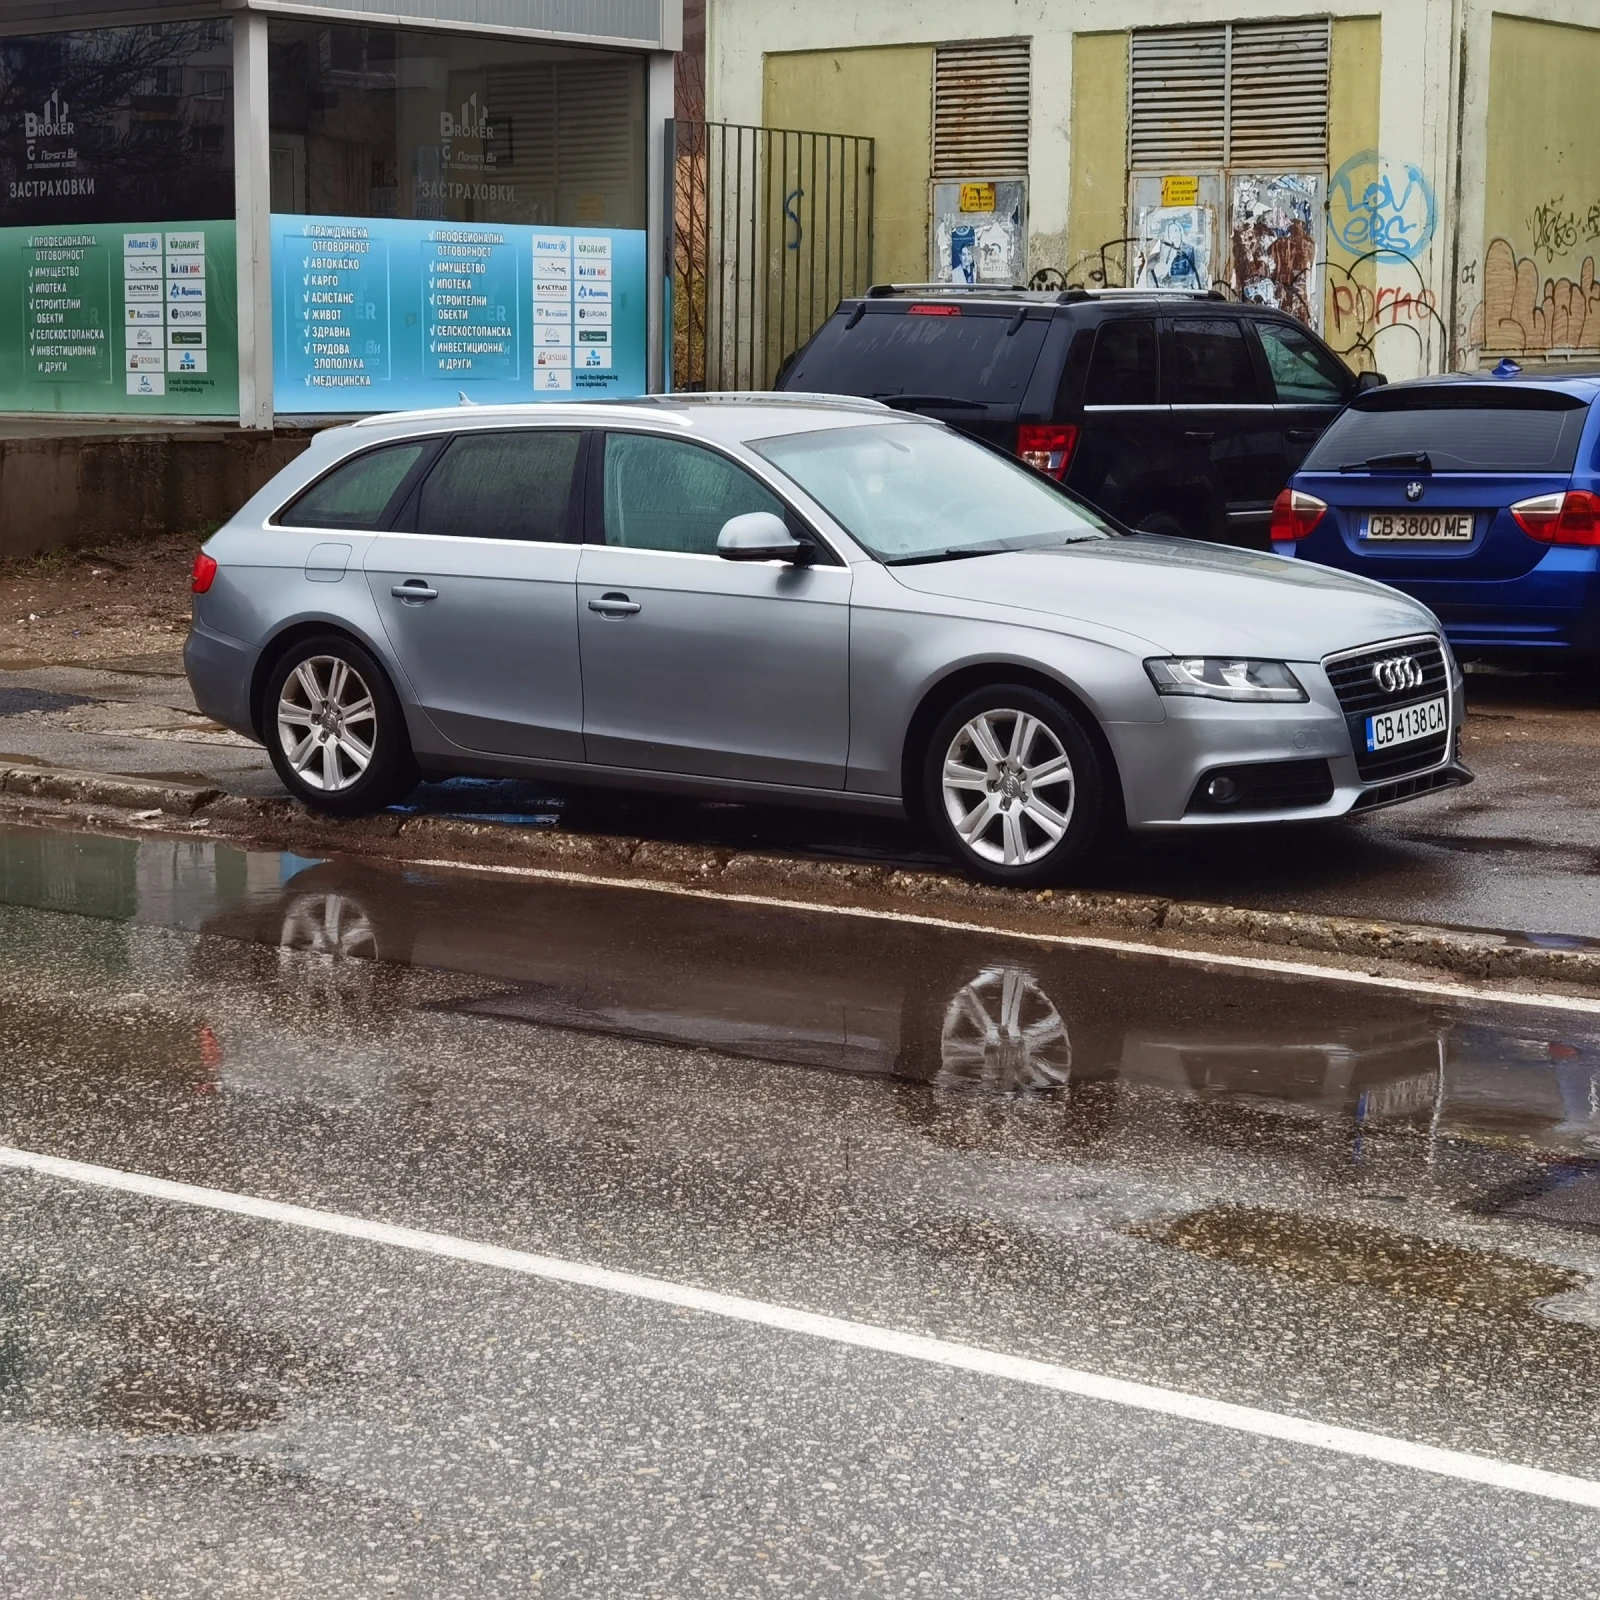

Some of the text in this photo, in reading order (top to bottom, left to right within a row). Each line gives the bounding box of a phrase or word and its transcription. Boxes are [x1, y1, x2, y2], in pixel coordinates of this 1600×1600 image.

[10, 178, 95, 198] ЗАСТРАХОВКИ
[422, 181, 515, 201] ЗАСТРАХОВКИ
[310, 225, 369, 239] ГРАЖДАНСКА
[436, 231, 504, 244] ПРОФЕСИОНАЛНА
[34, 235, 97, 247] ПРОФЕСИОНАЛНА
[128, 239, 149, 249] Allianz
[179, 240, 200, 250] GRAWE
[312, 240, 371, 253] ОТГОВОРНОСТ
[536, 241, 558, 250] Allianz
[36, 250, 85, 261] ОТГОВОРНОСТ
[437, 245, 492, 257] ОТГОВОРНОСТ
[586, 245, 607, 254] GRAWE
[311, 258, 360, 270] АВТОКАСКО
[436, 261, 486, 274] ИМУЩЕСТВО
[35, 266, 80, 278] ИМУЩЕСТВО
[311, 275, 338, 286] КАРГО
[436, 279, 472, 290] ИПОТЕКА
[35, 283, 67, 293] ИПОТЕКА
[311, 292, 354, 304] АСИСТАНС
[436, 295, 487, 306] СТРОИТЕЛНИ
[35, 299, 81, 310] СТРОИТЕЛНИ
[36, 313, 64, 324] ОБЕКТИ
[312, 309, 342, 320] ЖИВОТ
[438, 309, 468, 320] ОБЕКТИ
[36, 329, 105, 340] СЕЛСКОСТОПАНСКА
[312, 326, 351, 339] ЗДРАВНА
[437, 325, 512, 337] СЕЛСКОСТОПАНСКА
[36, 345, 97, 357] ИНВЕСТИЦИОННА
[312, 343, 350, 356] ТРУДОВА
[437, 342, 503, 354] ИНВЕСТИЦИОННА
[38, 361, 68, 374] И ДРУГИ
[313, 358, 364, 369] ЗЛОПОЛУКА
[438, 358, 472, 370] И ДРУГИ
[312, 375, 371, 387] МЕДИЦИНСКА
